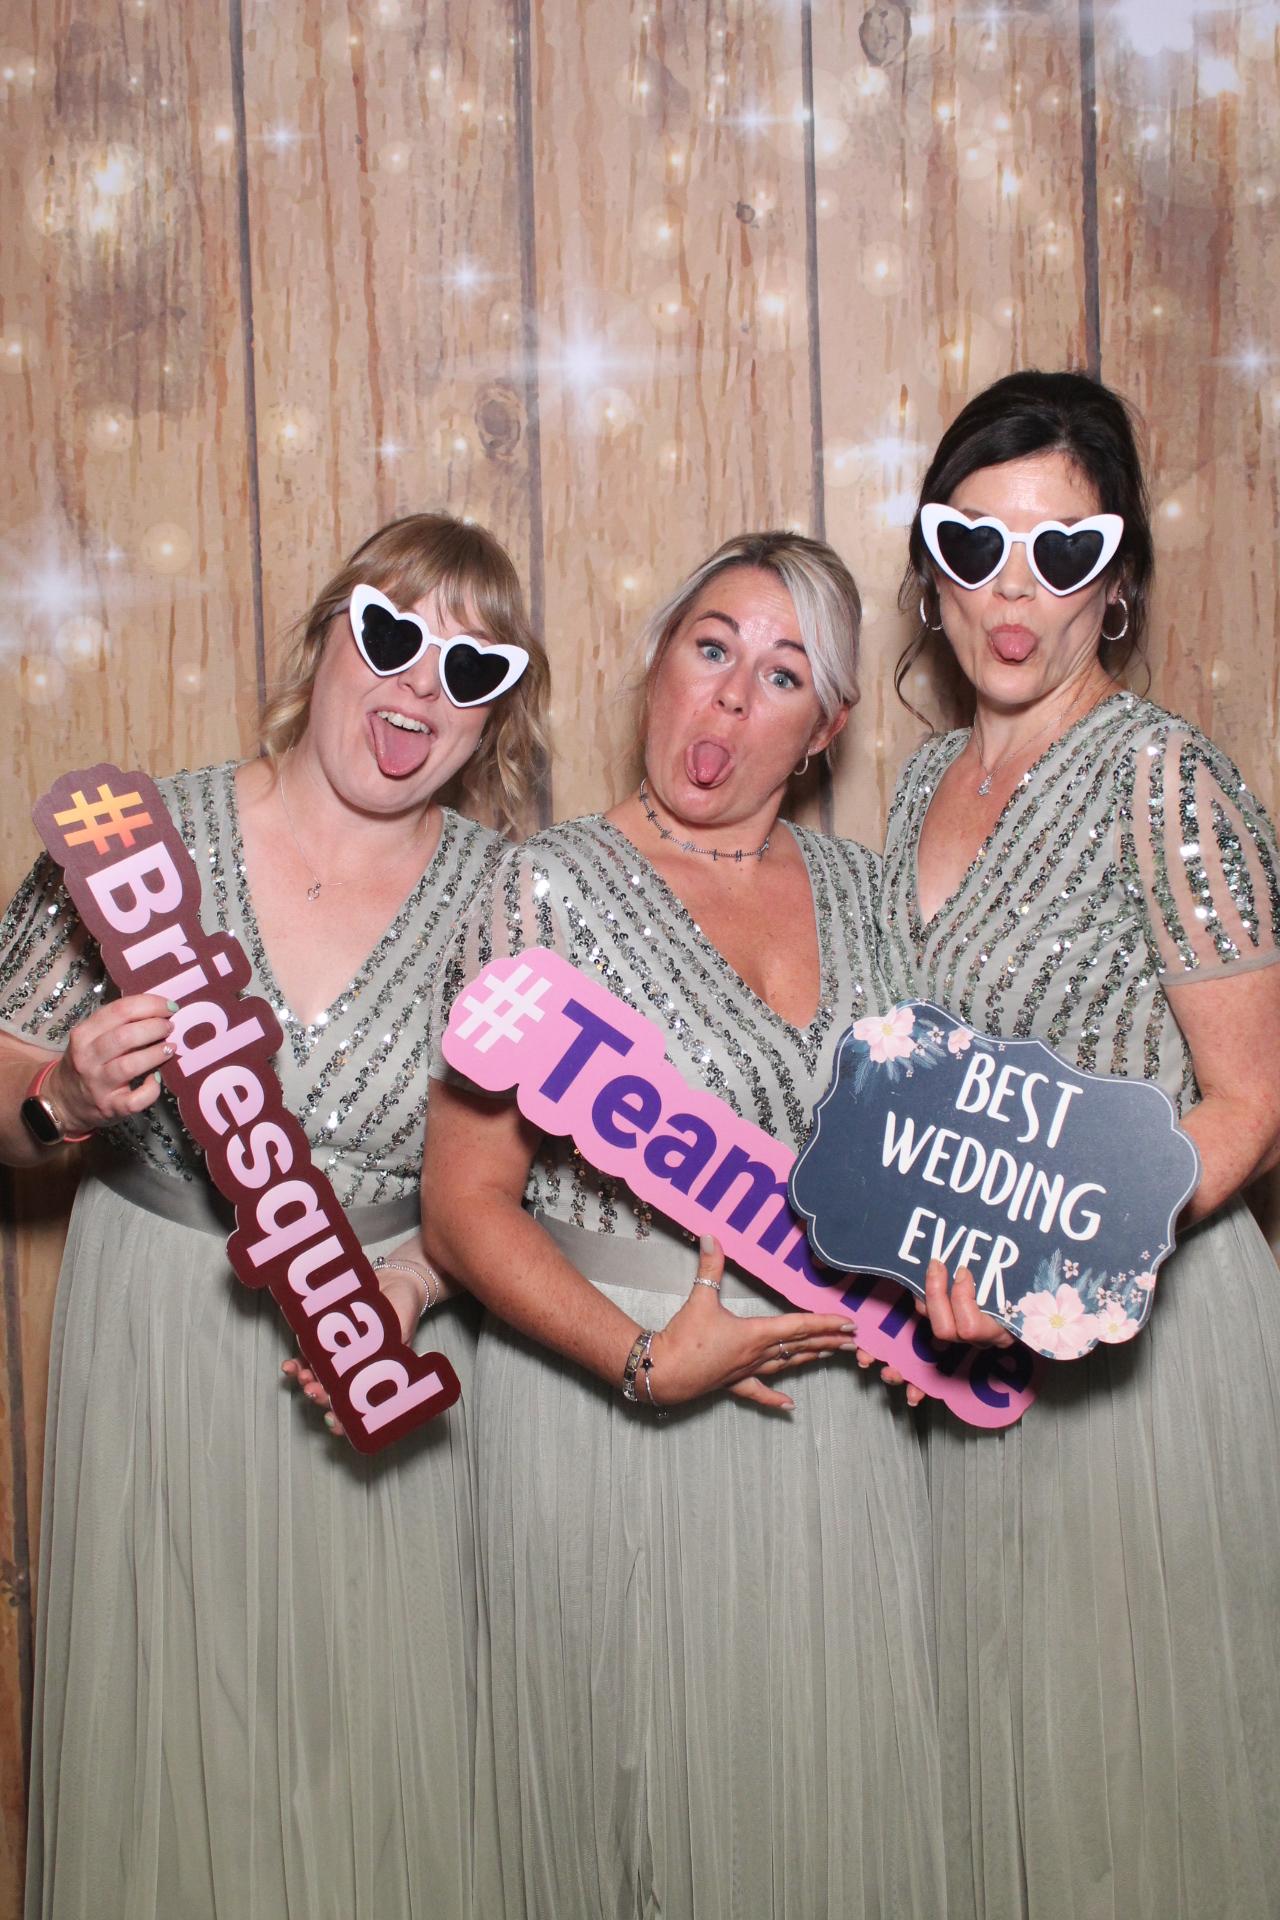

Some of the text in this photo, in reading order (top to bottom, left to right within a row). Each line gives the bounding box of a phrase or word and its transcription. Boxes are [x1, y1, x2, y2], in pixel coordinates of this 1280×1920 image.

[53, 783, 443, 1434] #Bridesquad
[955, 1053, 1083, 1148] BEST
[454, 963, 1034, 1408] #Teame
[882, 1111, 1106, 1240] WEDDING
[898, 1207, 1019, 1309] EVER
